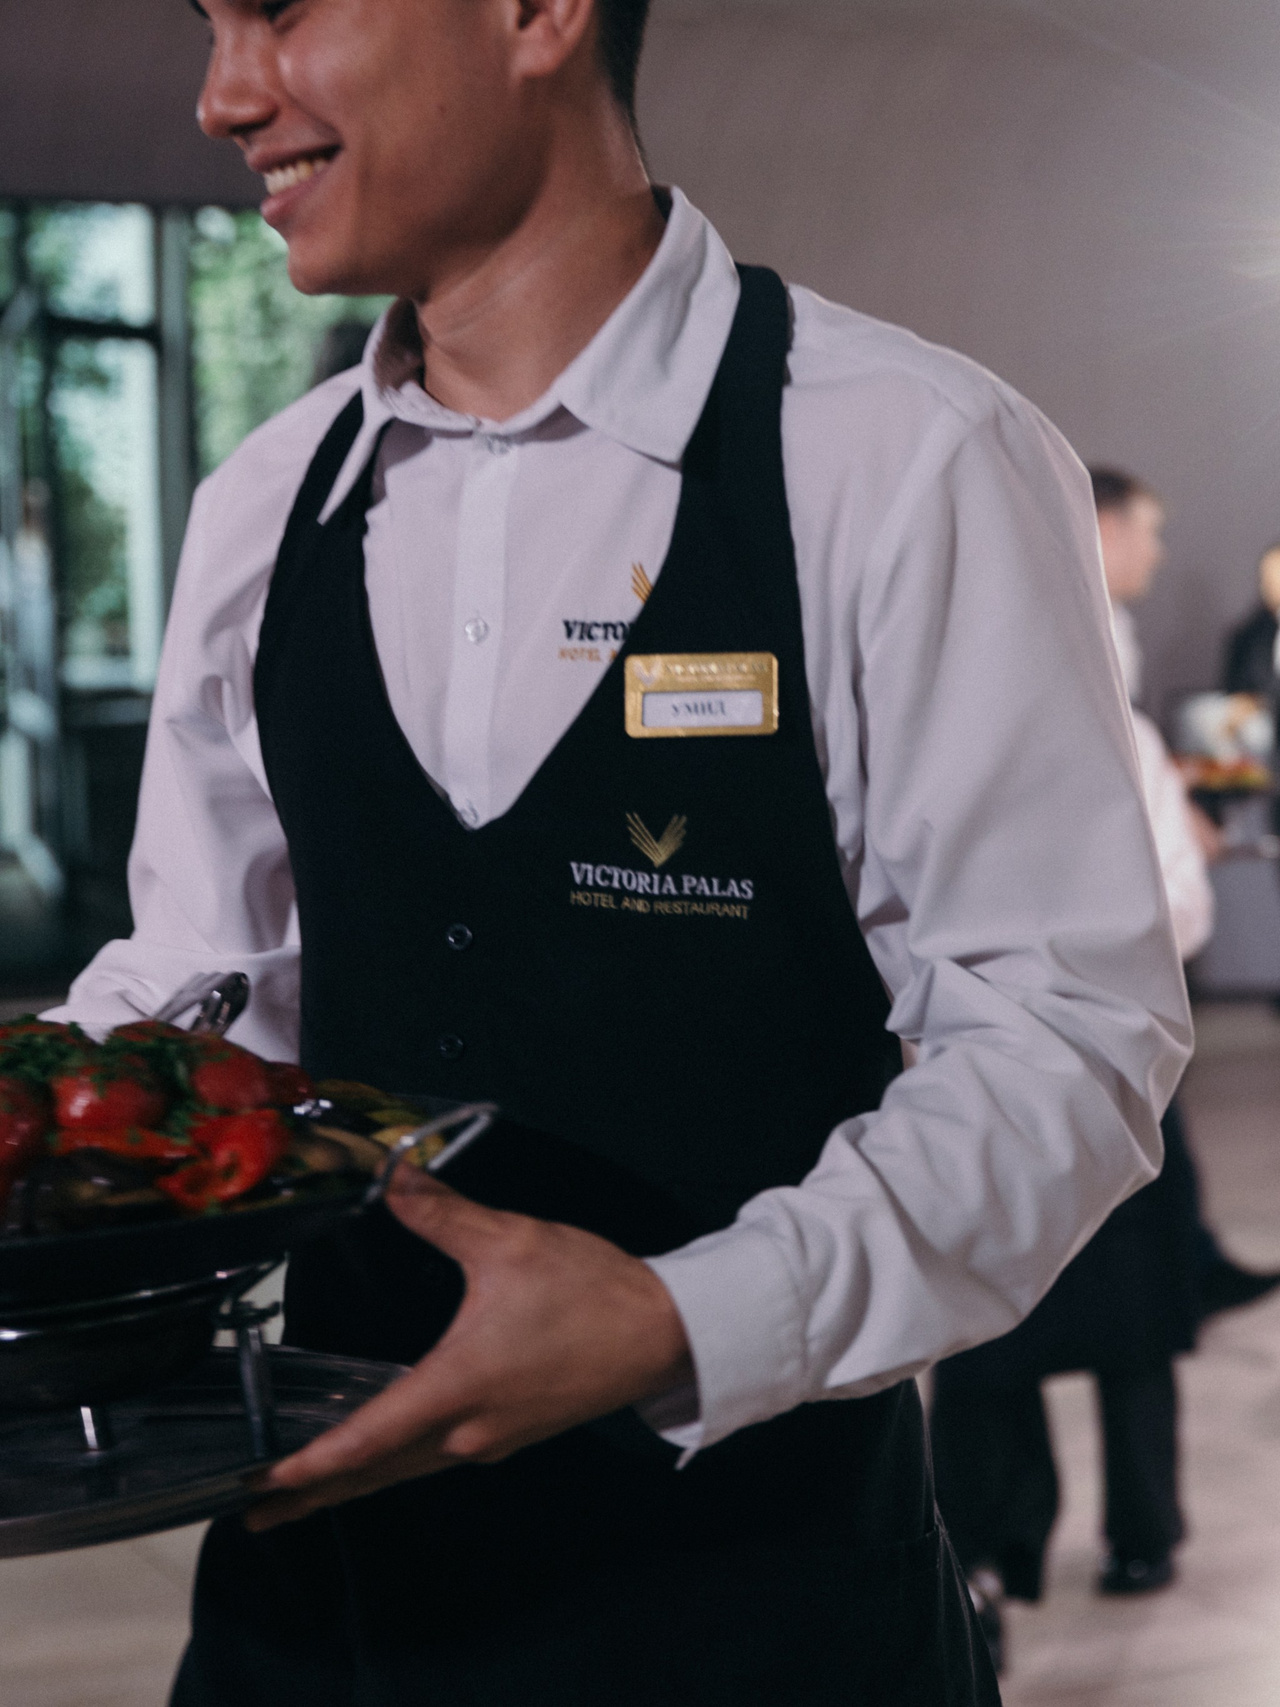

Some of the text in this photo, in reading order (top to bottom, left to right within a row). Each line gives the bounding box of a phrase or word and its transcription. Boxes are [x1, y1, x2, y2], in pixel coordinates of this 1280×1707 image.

[562, 620, 632, 641] VICTO
[570, 861, 754, 900] VICTORIA PALAS
[570, 891, 750, 920] HOTEL AND RESTAURANT
